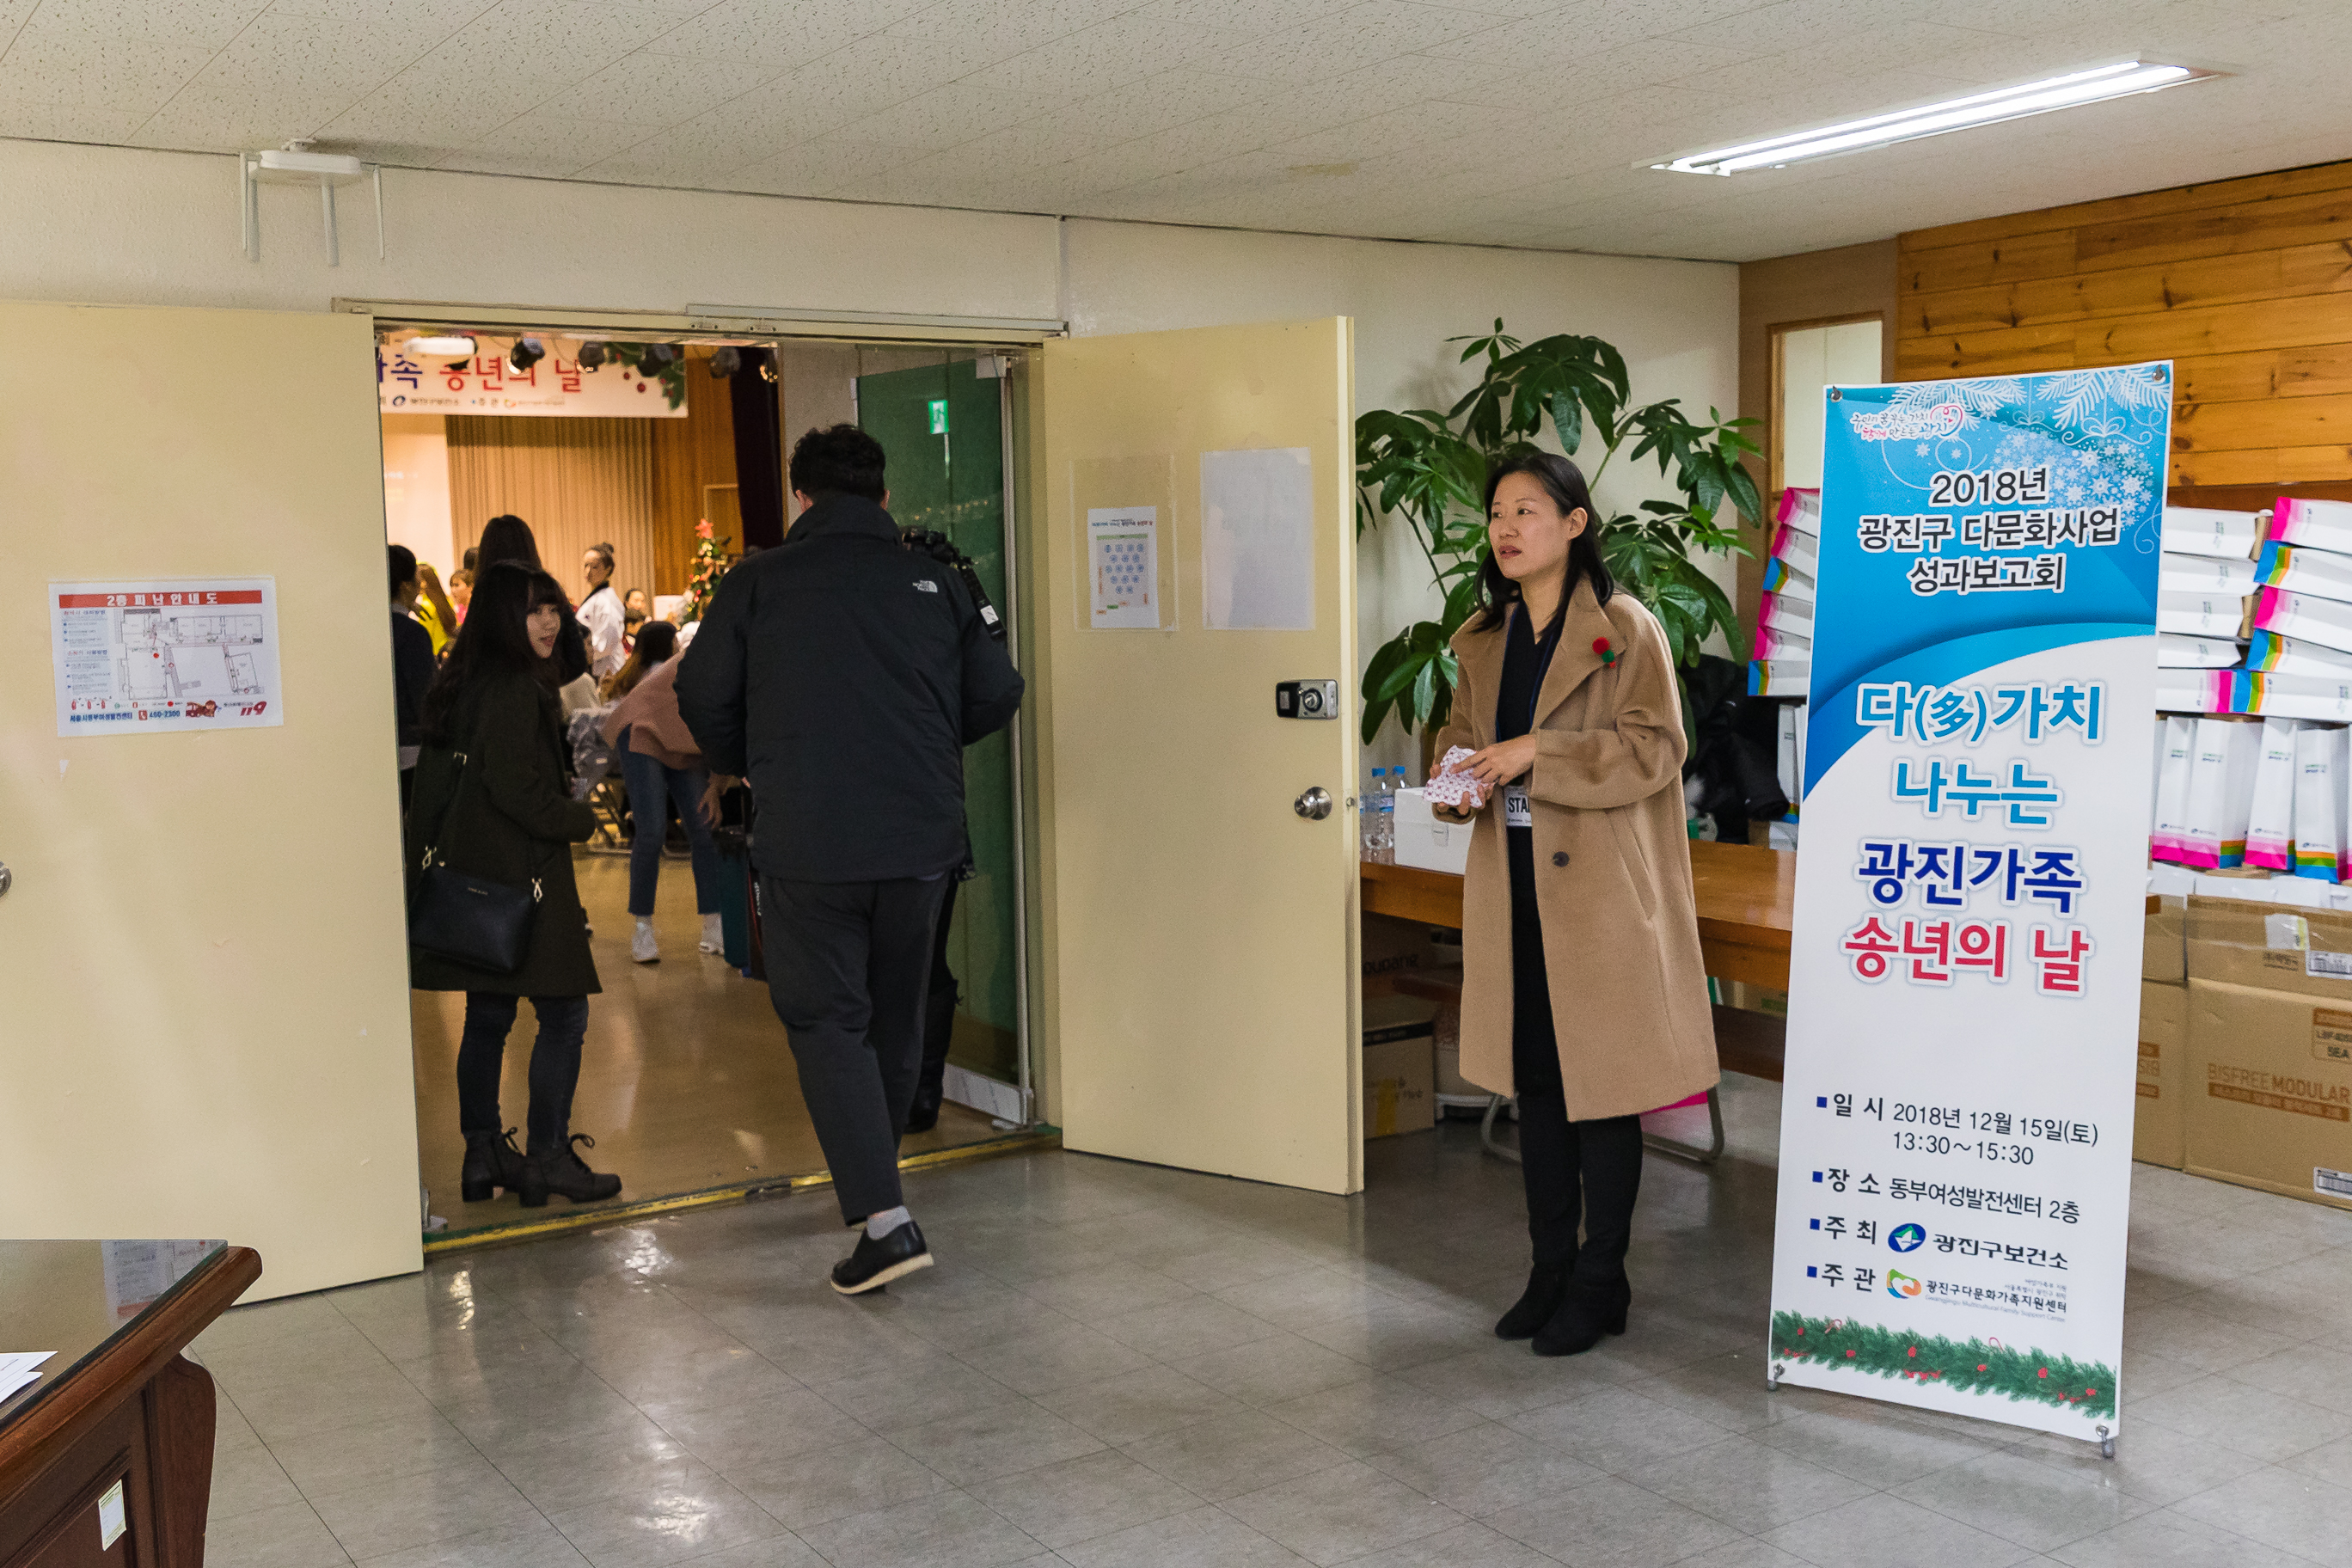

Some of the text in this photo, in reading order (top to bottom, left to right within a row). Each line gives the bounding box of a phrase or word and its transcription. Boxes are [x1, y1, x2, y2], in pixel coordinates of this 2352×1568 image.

[1932, 467, 2048, 505] 2018년
[1859, 508, 2119, 550] 광진구 다문화사업
[1910, 555, 2063, 593] 성과보고회
[107, 594, 127, 607] 2층
[1861, 685, 2100, 743] 다(多)가치
[1896, 762, 2058, 825] 나누는
[1859, 842, 2082, 914] 광진가족
[1845, 916, 2090, 992] 송년의 날
[2272, 1075, 2350, 1105] MODULAR
[1893, 1103, 1962, 1130] 2018년
[1969, 1112, 2012, 1136] 12월
[2020, 1117, 2098, 1148] 15일(토)
[1889, 1178, 2043, 1220] 동부여성발전센터
[2049, 1199, 2080, 1225] 2층
[1932, 1234, 2069, 1271] 광진구보건소
[1926, 1279, 2067, 1314] 광진구다문화가족지원센터
